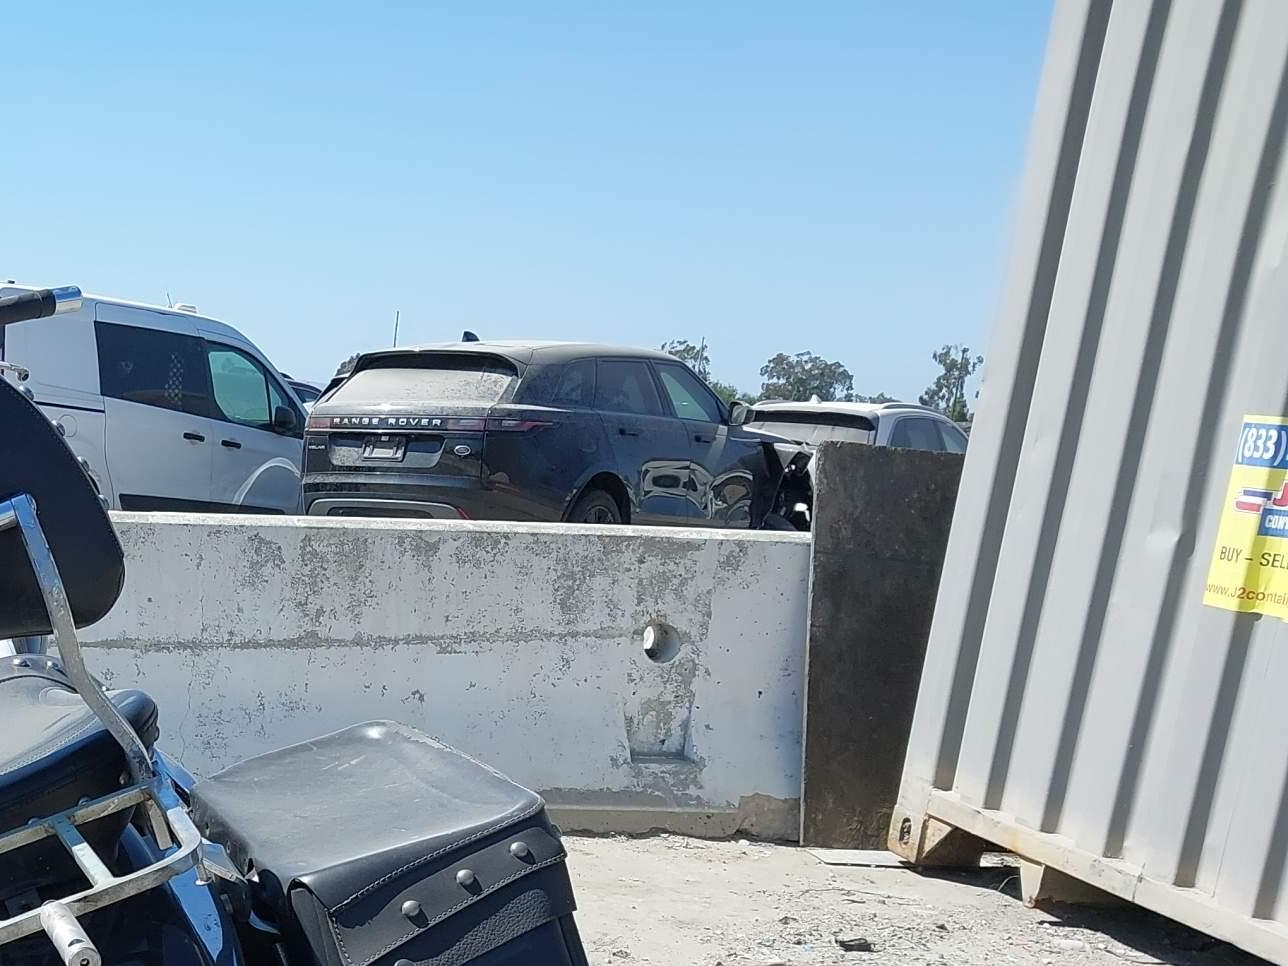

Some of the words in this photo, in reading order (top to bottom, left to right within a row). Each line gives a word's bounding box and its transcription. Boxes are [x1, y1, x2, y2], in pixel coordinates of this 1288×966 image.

[333, 417, 380, 425] RANGE
[388, 418, 442, 426] ROVER
[1238, 427, 1287, 466] (833)
[1219, 545, 1243, 563] BUY
[1259, 552, 1288, 570] SEL
[1206, 583, 1288, 606] www.J2contai
